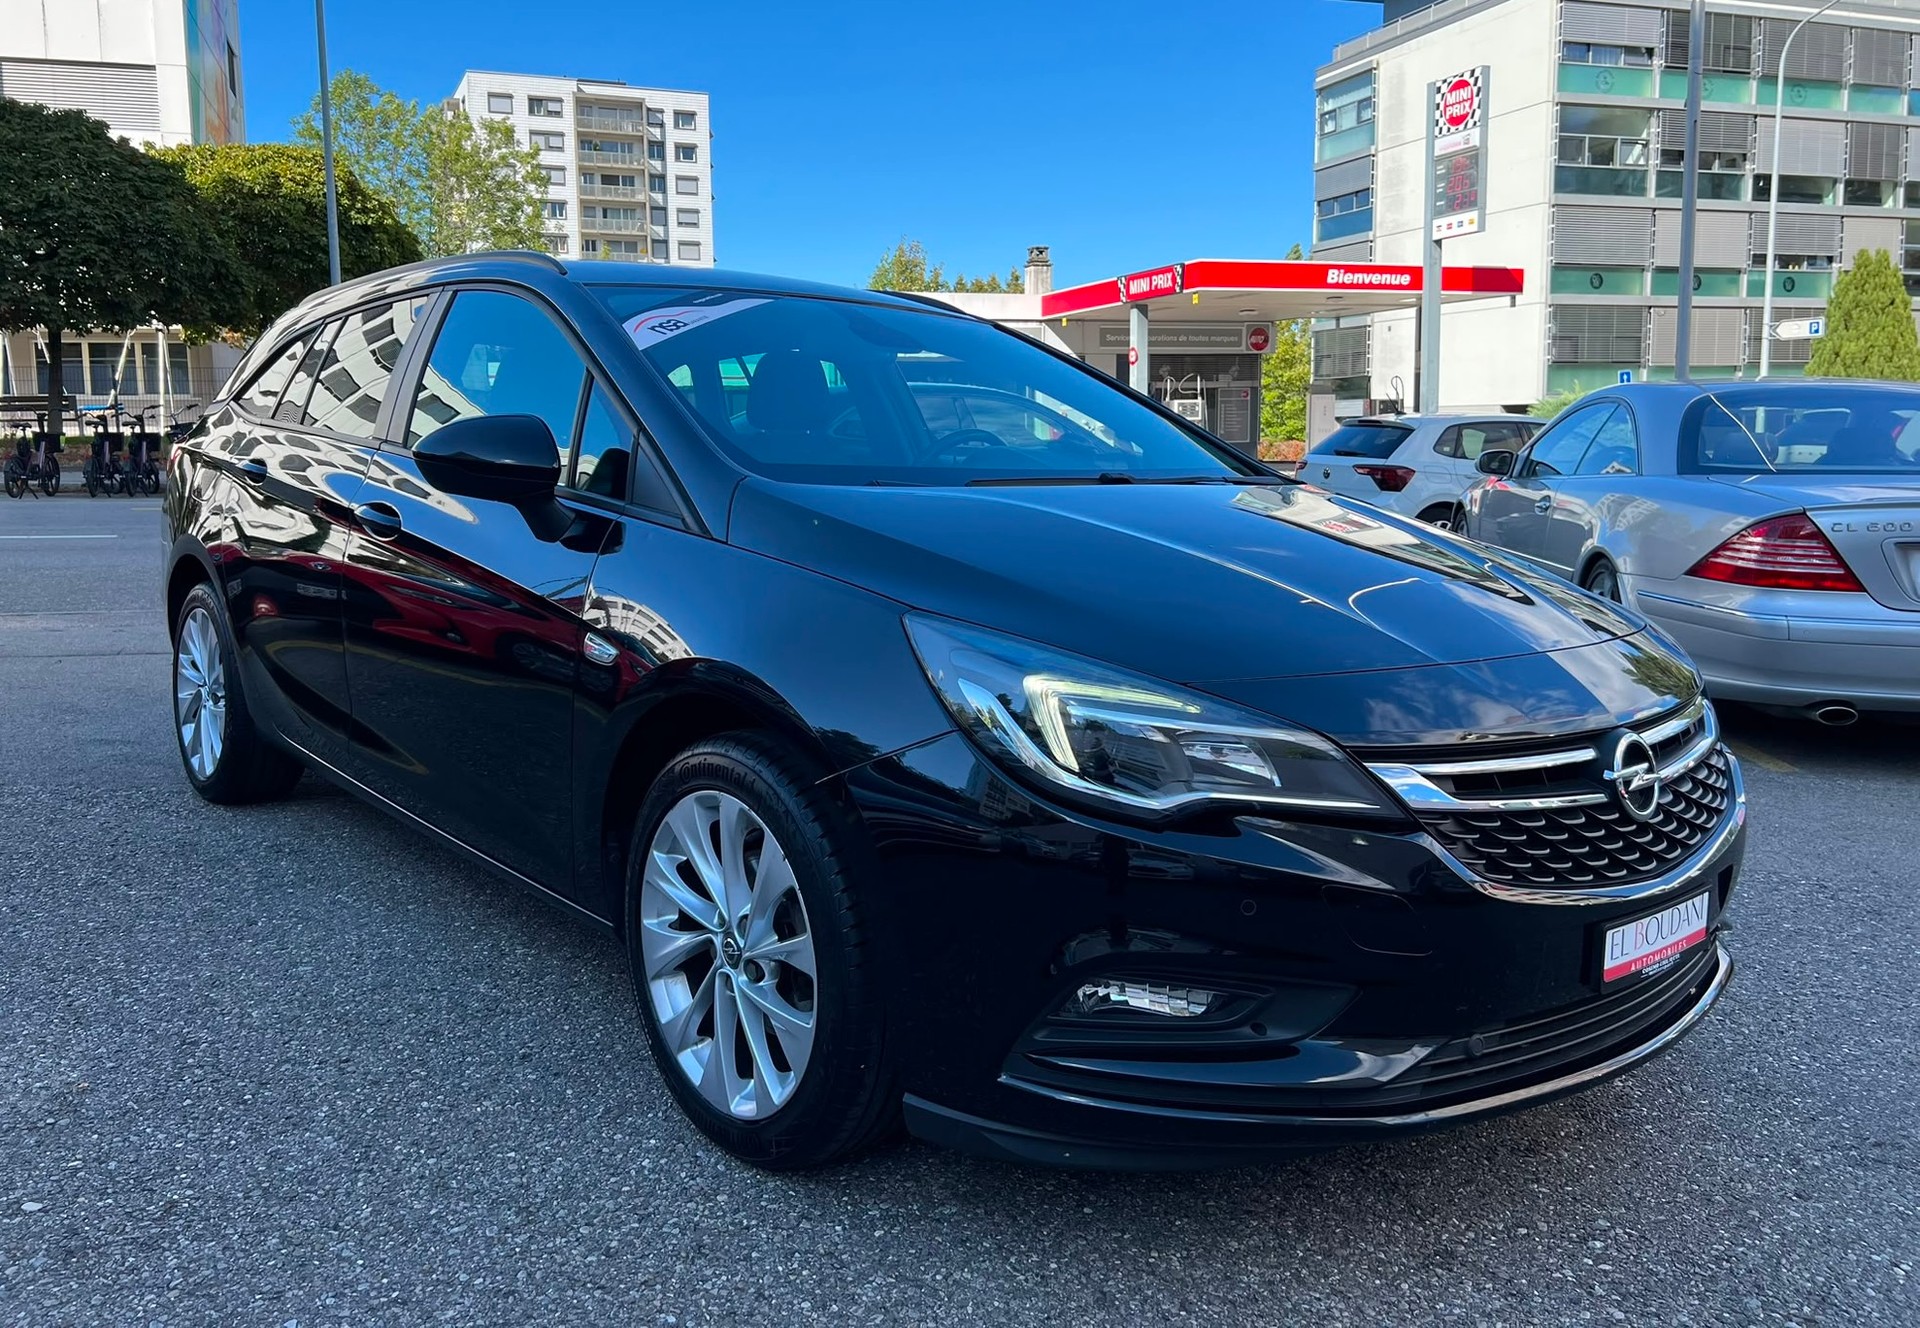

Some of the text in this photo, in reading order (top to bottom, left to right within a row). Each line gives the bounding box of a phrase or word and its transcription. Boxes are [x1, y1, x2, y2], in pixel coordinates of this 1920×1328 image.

[1446, 86, 1471, 105] MINI
[1445, 100, 1470, 120] PRIX
[1129, 272, 1173, 295] MINI PRIX
[1326, 268, 1412, 286] Bienvenue
[1178, 334, 1188, 342] de
[1188, 334, 1209, 342] toutes
[1209, 335, 1239, 344] marques
[1831, 522, 1914, 532] CL 600
[680, 758, 748, 787] Continental
[1610, 893, 1704, 961] EL BOUDANI
[1630, 940, 1688, 972] AUTOMOBILES
